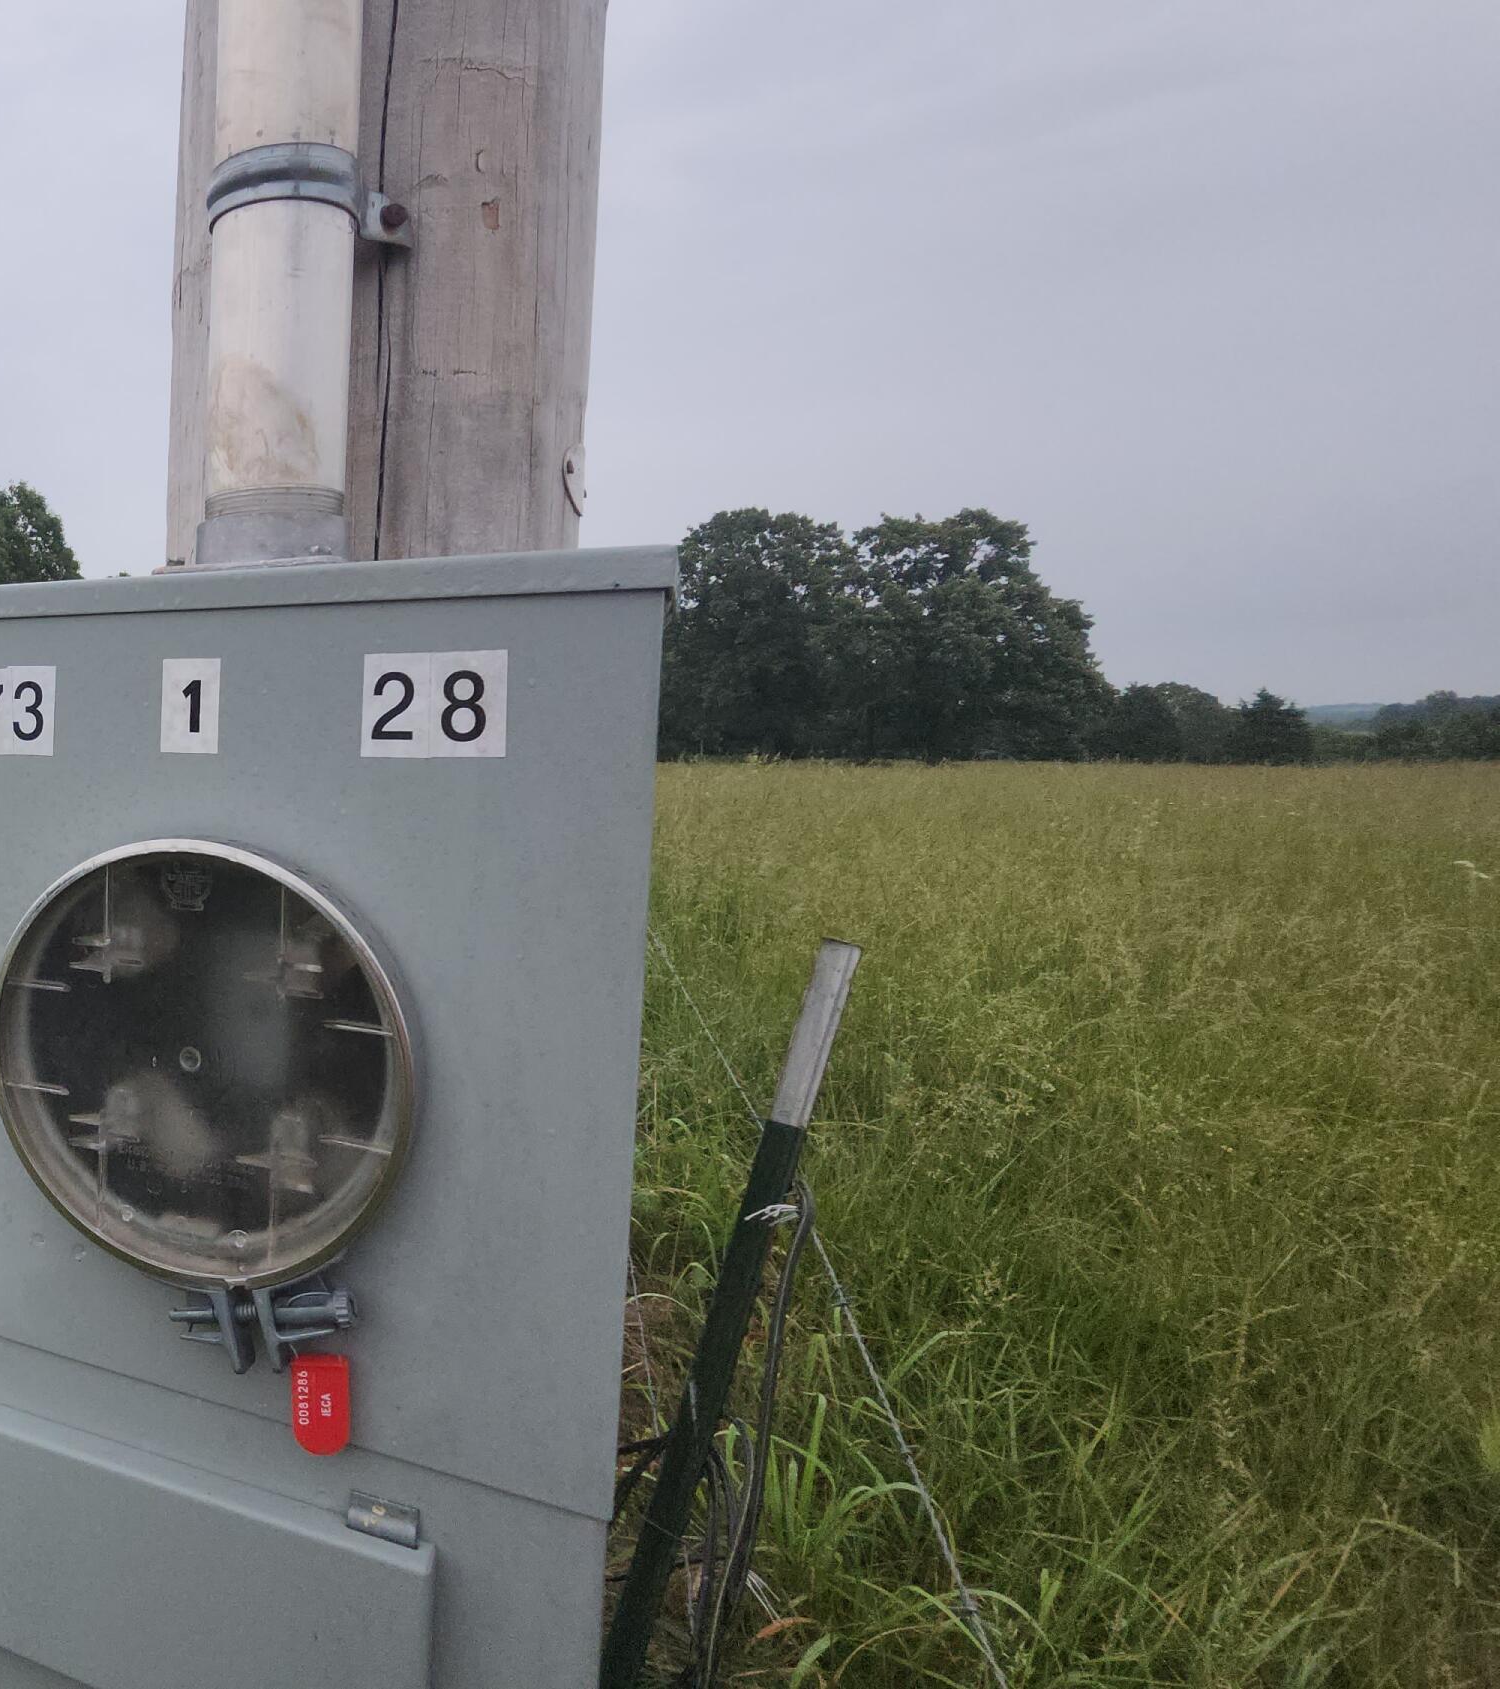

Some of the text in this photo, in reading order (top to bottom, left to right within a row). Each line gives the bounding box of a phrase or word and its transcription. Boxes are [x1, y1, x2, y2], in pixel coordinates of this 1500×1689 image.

[181, 680, 201, 733] 1
[370, 670, 487, 742] 28
[297, 1370, 309, 1425] 0081286
[321, 1393, 332, 1417] IECA
